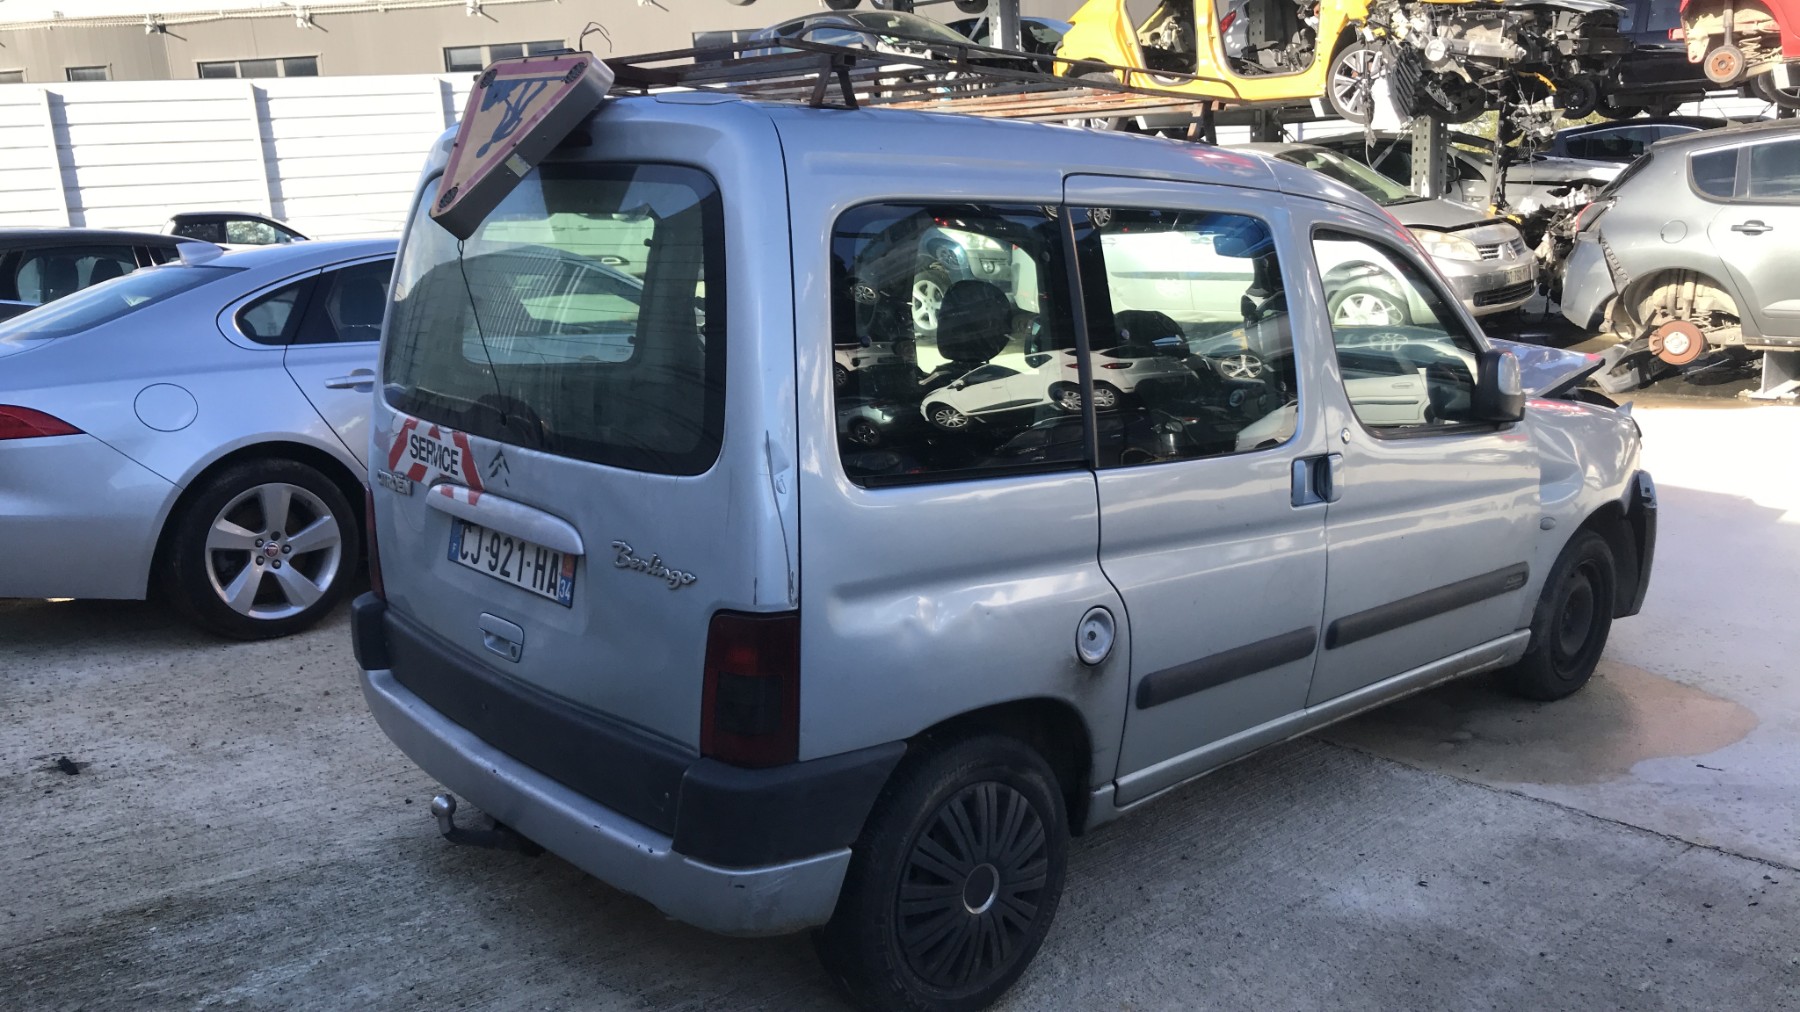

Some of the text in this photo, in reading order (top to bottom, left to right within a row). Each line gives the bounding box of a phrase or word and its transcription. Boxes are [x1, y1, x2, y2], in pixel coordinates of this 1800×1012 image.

[410, 434, 459, 476] SERVICE
[611, 540, 697, 590] Berlingo
[560, 579, 571, 600] 34
